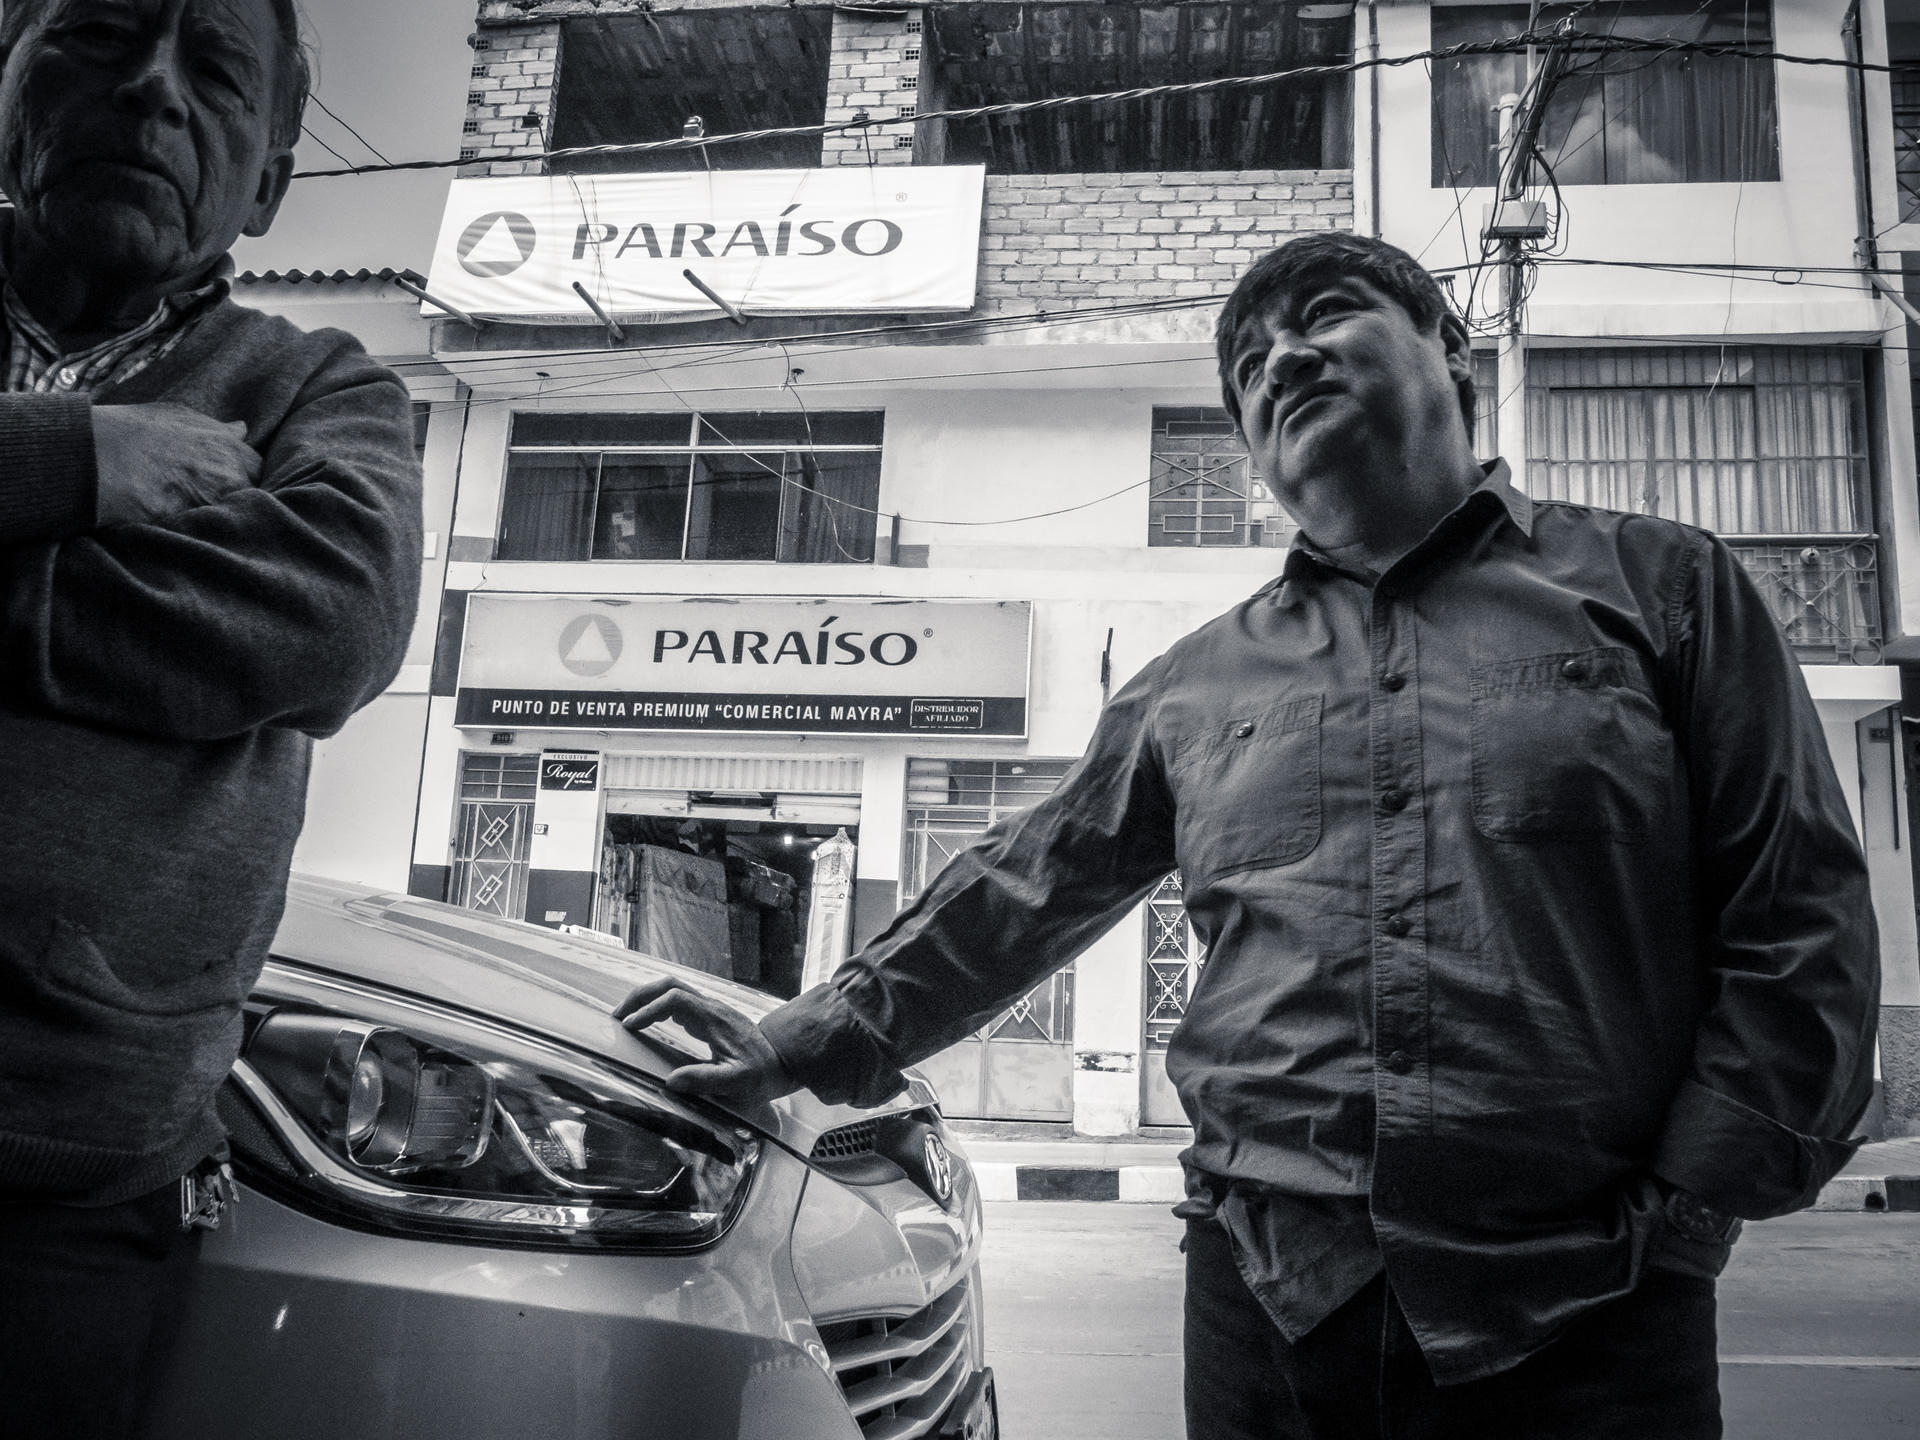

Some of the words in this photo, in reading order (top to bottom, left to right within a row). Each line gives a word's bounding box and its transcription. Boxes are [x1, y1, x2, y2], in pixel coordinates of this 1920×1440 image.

[572, 203, 903, 260] PARAÍSO
[653, 616, 918, 666] PARAÍSO
[492, 699, 543, 715] PUNTO
[550, 701, 570, 715] DE
[576, 701, 626, 716] VENTA
[633, 703, 710, 718] PREMIUM
[715, 704, 821, 720] “COMERCIAL
[830, 706, 902, 721] MAYRA”
[914, 705, 979, 713] DISTRIBUIDOR
[926, 714, 969, 722] AFILIADO
[543, 762, 597, 789] Royal
